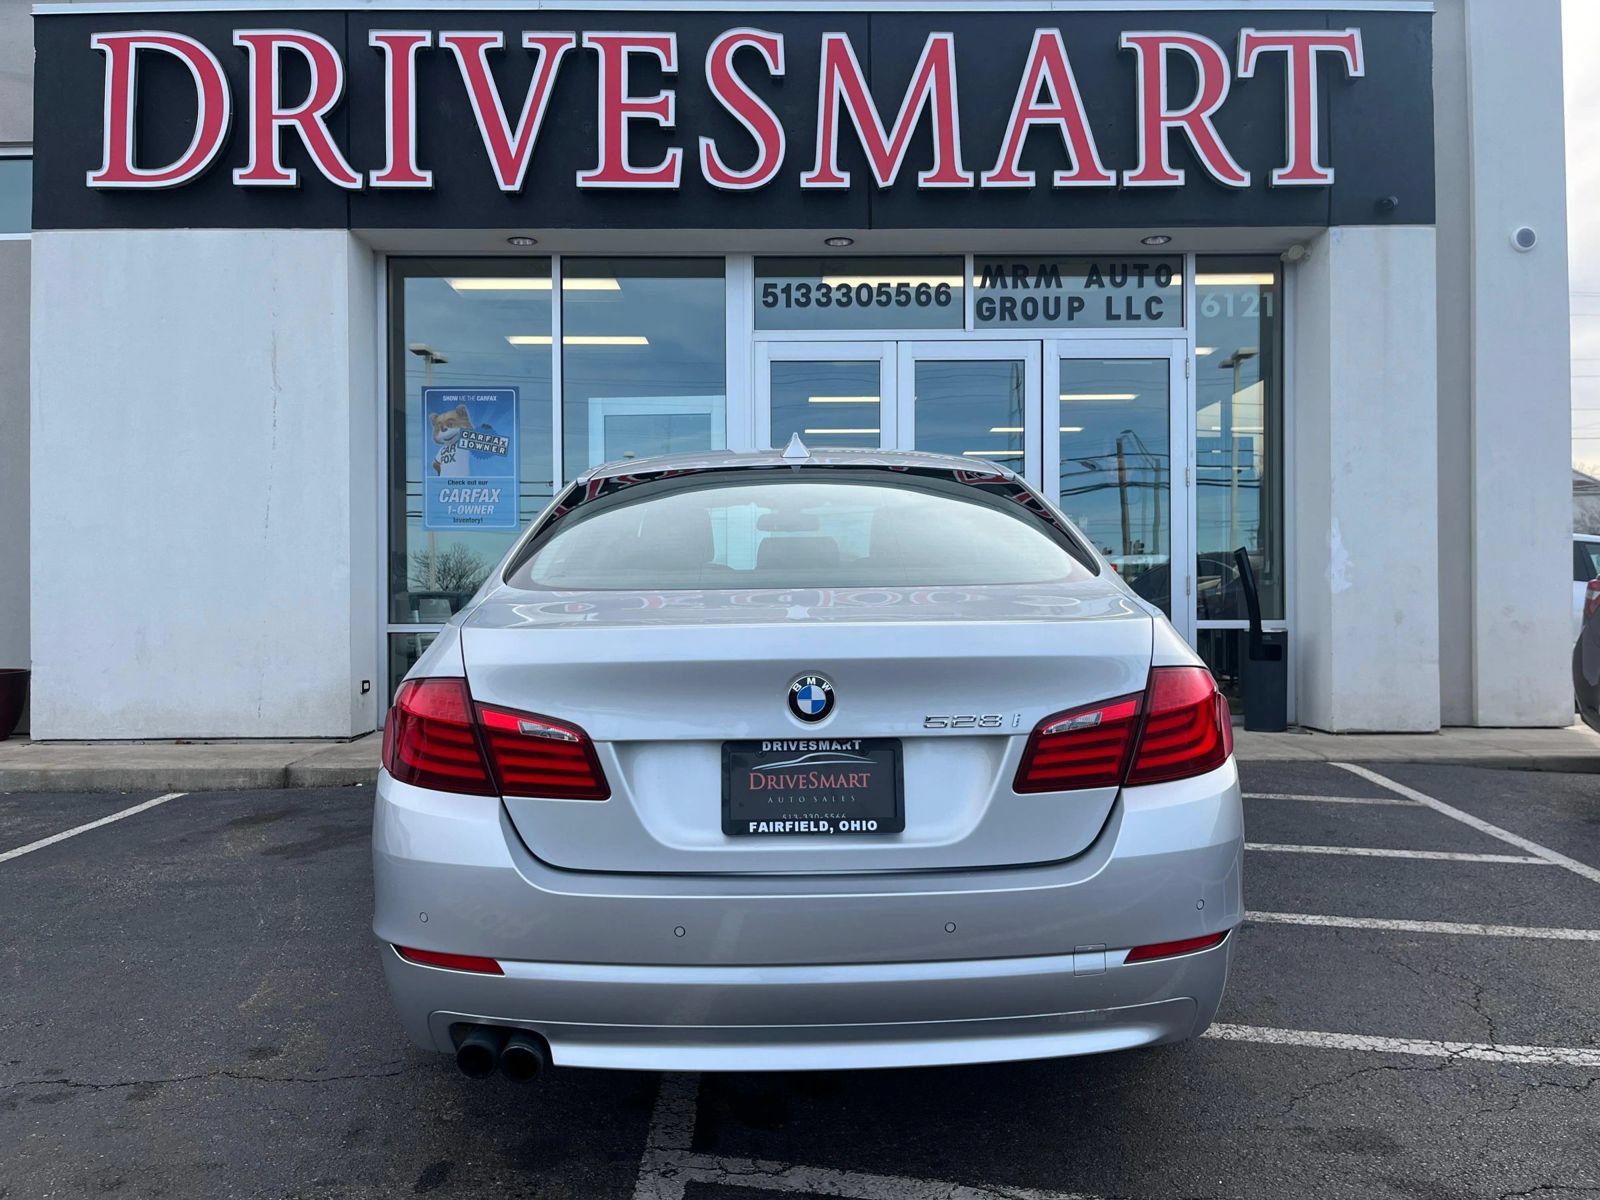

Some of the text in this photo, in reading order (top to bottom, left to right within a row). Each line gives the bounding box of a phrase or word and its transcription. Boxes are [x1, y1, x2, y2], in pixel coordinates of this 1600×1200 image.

[86, 27, 1366, 192] DRIVESMART
[979, 263, 1173, 289] MRM AUTO
[762, 282, 952, 308] 5133305566
[975, 296, 1164, 322] GROUP LLC
[1200, 291, 1273, 318] 6121
[462, 431, 508, 446] CARFAX
[441, 453, 457, 464] FOX
[440, 488, 501, 503] CARFAX
[447, 504, 495, 515] 1-OWNER
[792, 677, 832, 692] BMW
[762, 740, 862, 751] DRIVESMART
[767, 795, 856, 804] AUTO SALES
[749, 820, 878, 834] FAIRFIELD, OHIO
